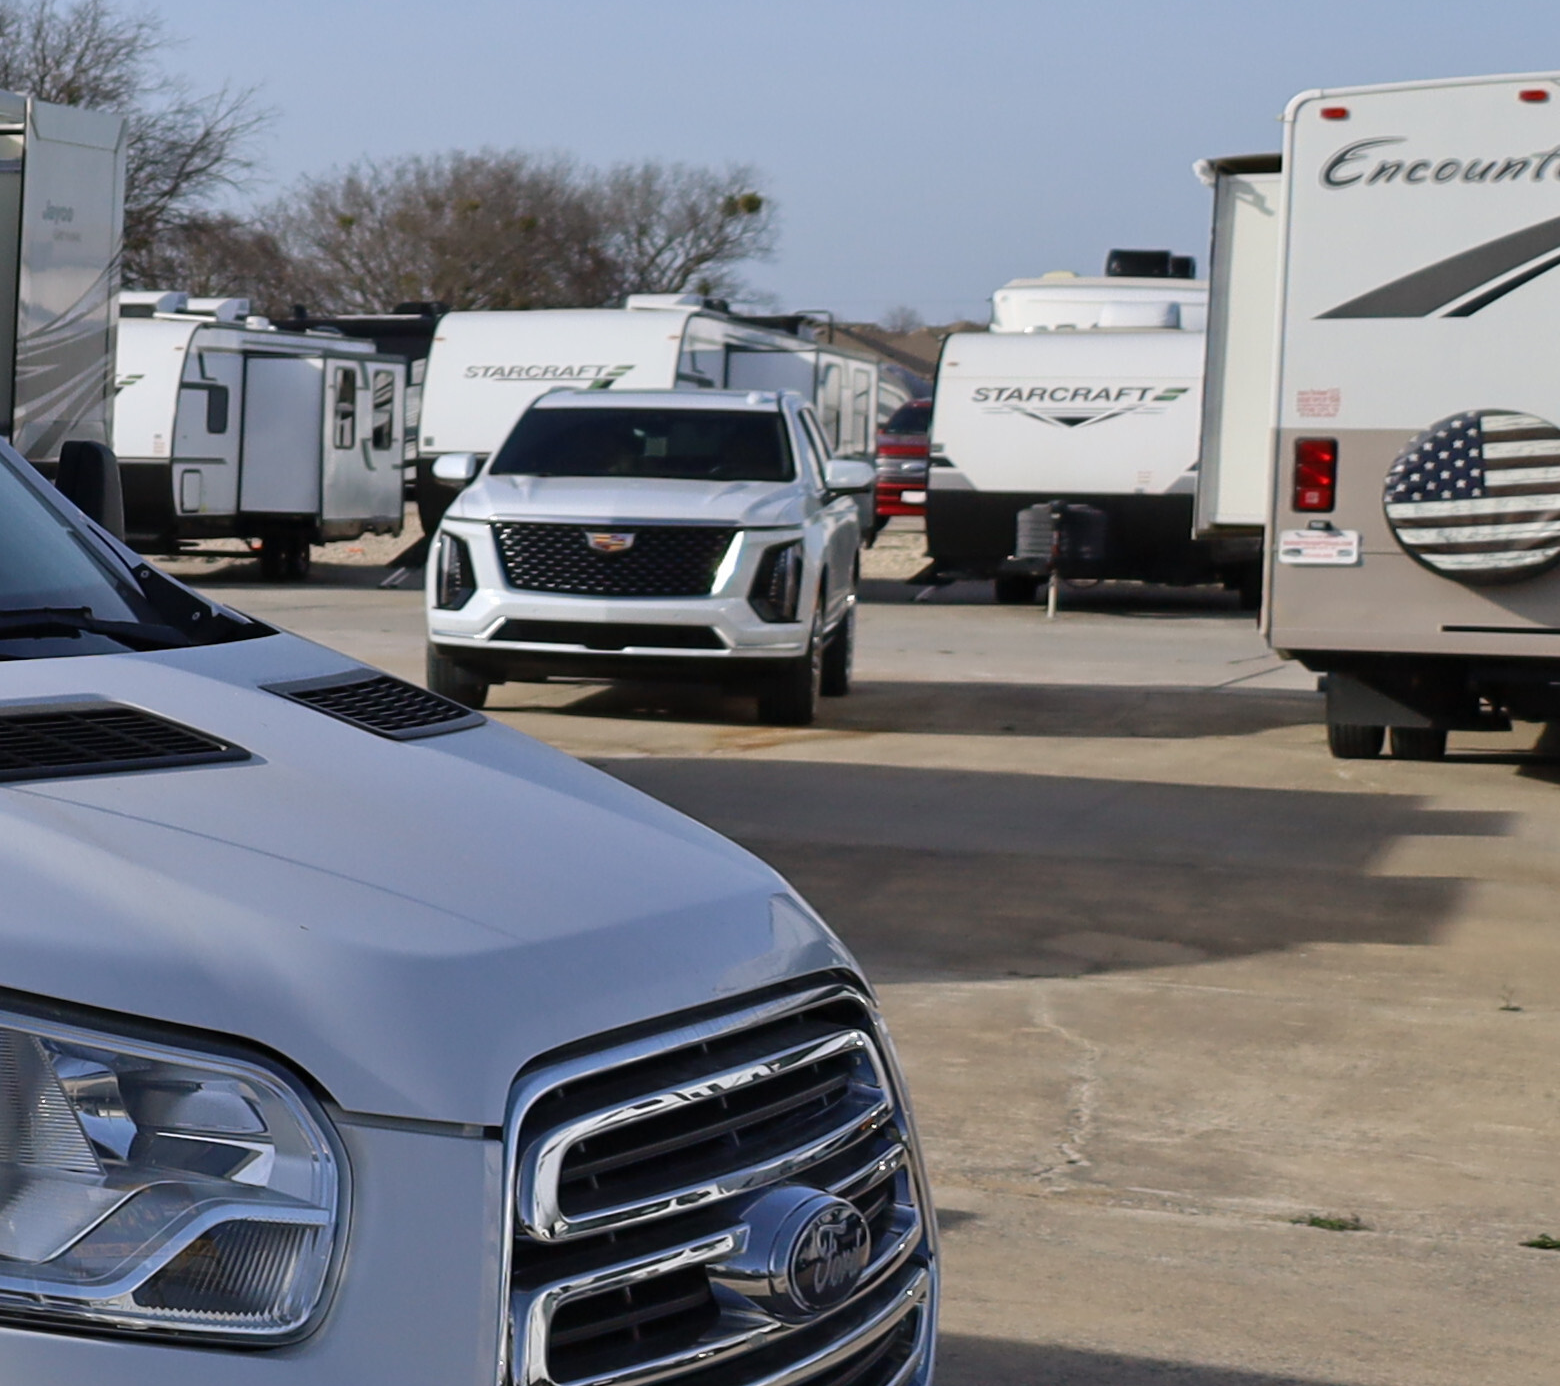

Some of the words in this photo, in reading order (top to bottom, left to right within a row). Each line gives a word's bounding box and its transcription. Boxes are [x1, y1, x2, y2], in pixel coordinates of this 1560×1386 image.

[1319, 135, 1560, 190] Encount
[464, 364, 610, 379] STARCRAFT
[972, 386, 1154, 403] STARCRAFT
[814, 1219, 862, 1293] Ford
